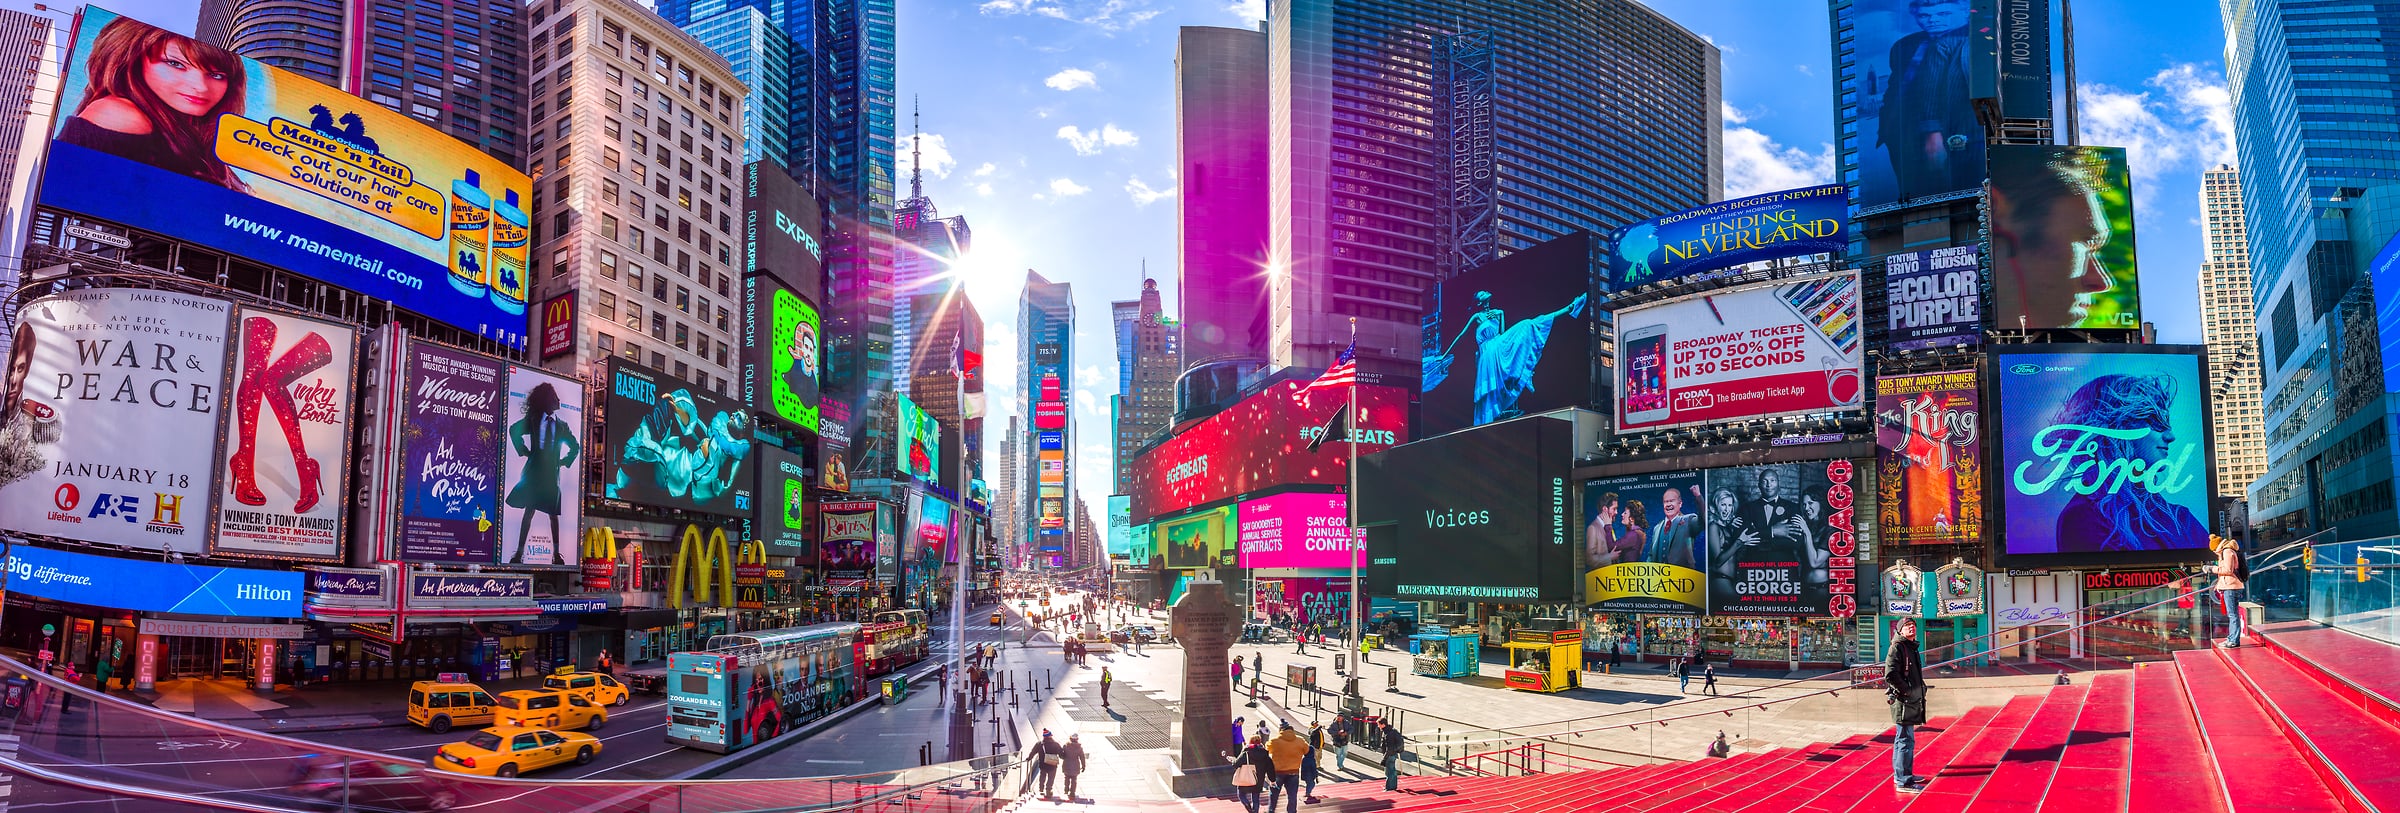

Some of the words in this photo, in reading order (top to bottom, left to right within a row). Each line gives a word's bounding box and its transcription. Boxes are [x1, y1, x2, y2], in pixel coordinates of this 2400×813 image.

[1473, 92, 1490, 181] OUTFITTERS
[279, 124, 337, 153] Mane
[369, 156, 404, 180] Tail
[233, 129, 295, 160] Check
[301, 154, 331, 173] out
[336, 166, 367, 184] our
[371, 178, 403, 199] hair
[406, 195, 439, 215] care
[748, 163, 758, 198] SNAPCHAT
[290, 165, 370, 205] Solutions
[375, 199, 393, 214] at
[1660, 204, 1727, 226] BROADWAY'S
[1730, 194, 1781, 210] BIGGEST
[1783, 189, 1813, 200] NEW
[1816, 186, 1844, 196] HIT!
[1710, 211, 1744, 221] MATTHEW
[1745, 204, 1783, 214] MORRISON
[748, 210, 757, 240] FOLLOW
[1701, 209, 1796, 237] FINDING
[72, 227, 90, 236] city
[92, 232, 126, 245] outdoor
[1663, 218, 1839, 264] NEVERLAND
[1887, 252, 1919, 264] CYNTHIA
[1930, 246, 1966, 259] JENNIFER
[1930, 254, 1977, 270] HUDSON
[1888, 262, 1919, 276] ERIVO
[1902, 270, 1977, 303] COLOR
[78, 292, 110, 300] JAMES
[130, 293, 167, 303] JAMES
[172, 297, 225, 313] NORTON
[137, 316, 167, 325] EPIC
[1889, 295, 1978, 331] PURPLE
[62, 324, 170, 335] THREE-NETWORK
[179, 330, 221, 343] EVENT
[549, 323, 568, 334] OPEN
[746, 302, 755, 348] SNAPCHAT
[1922, 326, 1957, 336] BROADWAY
[1673, 331, 1744, 351] BROADWAY
[1750, 323, 1805, 340] TICKETS
[1673, 350, 1696, 365] UP
[1699, 346, 1723, 362] TO
[1727, 340, 1763, 357] 50%
[1768, 335, 1805, 351] OFF
[420, 353, 431, 361] THE
[433, 355, 449, 365] MOST
[450, 359, 496, 376] AWARD-WINNING
[423, 361, 449, 373] MUSICAL
[459, 370, 470, 378] THE
[470, 372, 494, 383] SEASON!
[1673, 365, 1691, 379] IN
[1694, 361, 1716, 376] 30
[1720, 350, 1805, 373] SECONDS
[616, 372, 656, 406] BASKETS
[1878, 379, 1894, 388] 2015
[1896, 378, 1914, 387] TONY
[1916, 376, 1943, 385] AWARD
[1943, 373, 1976, 383] WINNER!
[1897, 385, 1925, 393] REVIVAL
[53, 373, 212, 414] PEACE
[418, 375, 496, 410] Winner!
[1678, 388, 1710, 400] TODAY
[1716, 393, 1729, 403] The
[1730, 390, 1765, 403] Broadway
[1766, 387, 1790, 398] Ticket
[1790, 385, 1805, 397] App
[417, 400, 431, 414] 4
[433, 404, 448, 415] 2015
[450, 407, 468, 419] TONY
[468, 412, 493, 423] AWARDS
[1686, 398, 1703, 408] TIX
[1878, 409, 1903, 427] The
[1894, 394, 1978, 452] King
[436, 436, 454, 460] An
[2013, 423, 2197, 496] Ford
[54, 461, 158, 485] JANUARY
[167, 472, 190, 489] 18
[421, 452, 487, 491] American
[432, 478, 474, 504] Paris
[48, 511, 81, 524] Lifetime
[224, 509, 264, 525] WINNER!
[266, 513, 271, 525] 6
[274, 515, 297, 527] TONY
[299, 517, 334, 530] AWARDS
[1426, 509, 1490, 529] Voices
[1553, 477, 1563, 545] SAMSUNG
[146, 524, 185, 535] HISTORY
[224, 523, 265, 532] INCLUDING
[294, 529, 333, 538] MUSICAL
[1242, 522, 1251, 531] SAY
[1251, 519, 1274, 530] GOODBYE
[1275, 518, 1282, 526] TO
[1306, 517, 1326, 526] SAY
[1242, 531, 1260, 540] ANNUAL
[1261, 528, 1282, 539] SERVICE
[1306, 528, 1346, 536] ANNUAL
[1826, 459, 1856, 618] CHICAGO
[1242, 539, 1282, 553] CONTRACTS
[8, 554, 32, 580] Big
[33, 564, 92, 586] difference.
[1616, 566, 1671, 576] FINDING
[1747, 569, 1788, 582] EDDIE
[2086, 573, 2112, 588] DOS
[2115, 571, 2170, 587] CAMINOS
[236, 583, 292, 601] Hilton
[436, 577, 481, 596] American
[1595, 577, 1694, 595] NEVERLAND
[1735, 581, 1801, 595] GEORGE
[562, 603, 588, 611] MONEY
[592, 602, 606, 610] ATM
[1723, 605, 1815, 613] CHICAGOTHEMUSICAL.COM
[1659, 617, 1700, 628] GRAND
[1727, 619, 1767, 630] SLAM
[670, 695, 708, 705] ZOOLANDER
[782, 682, 831, 706] ZOOLANDER
